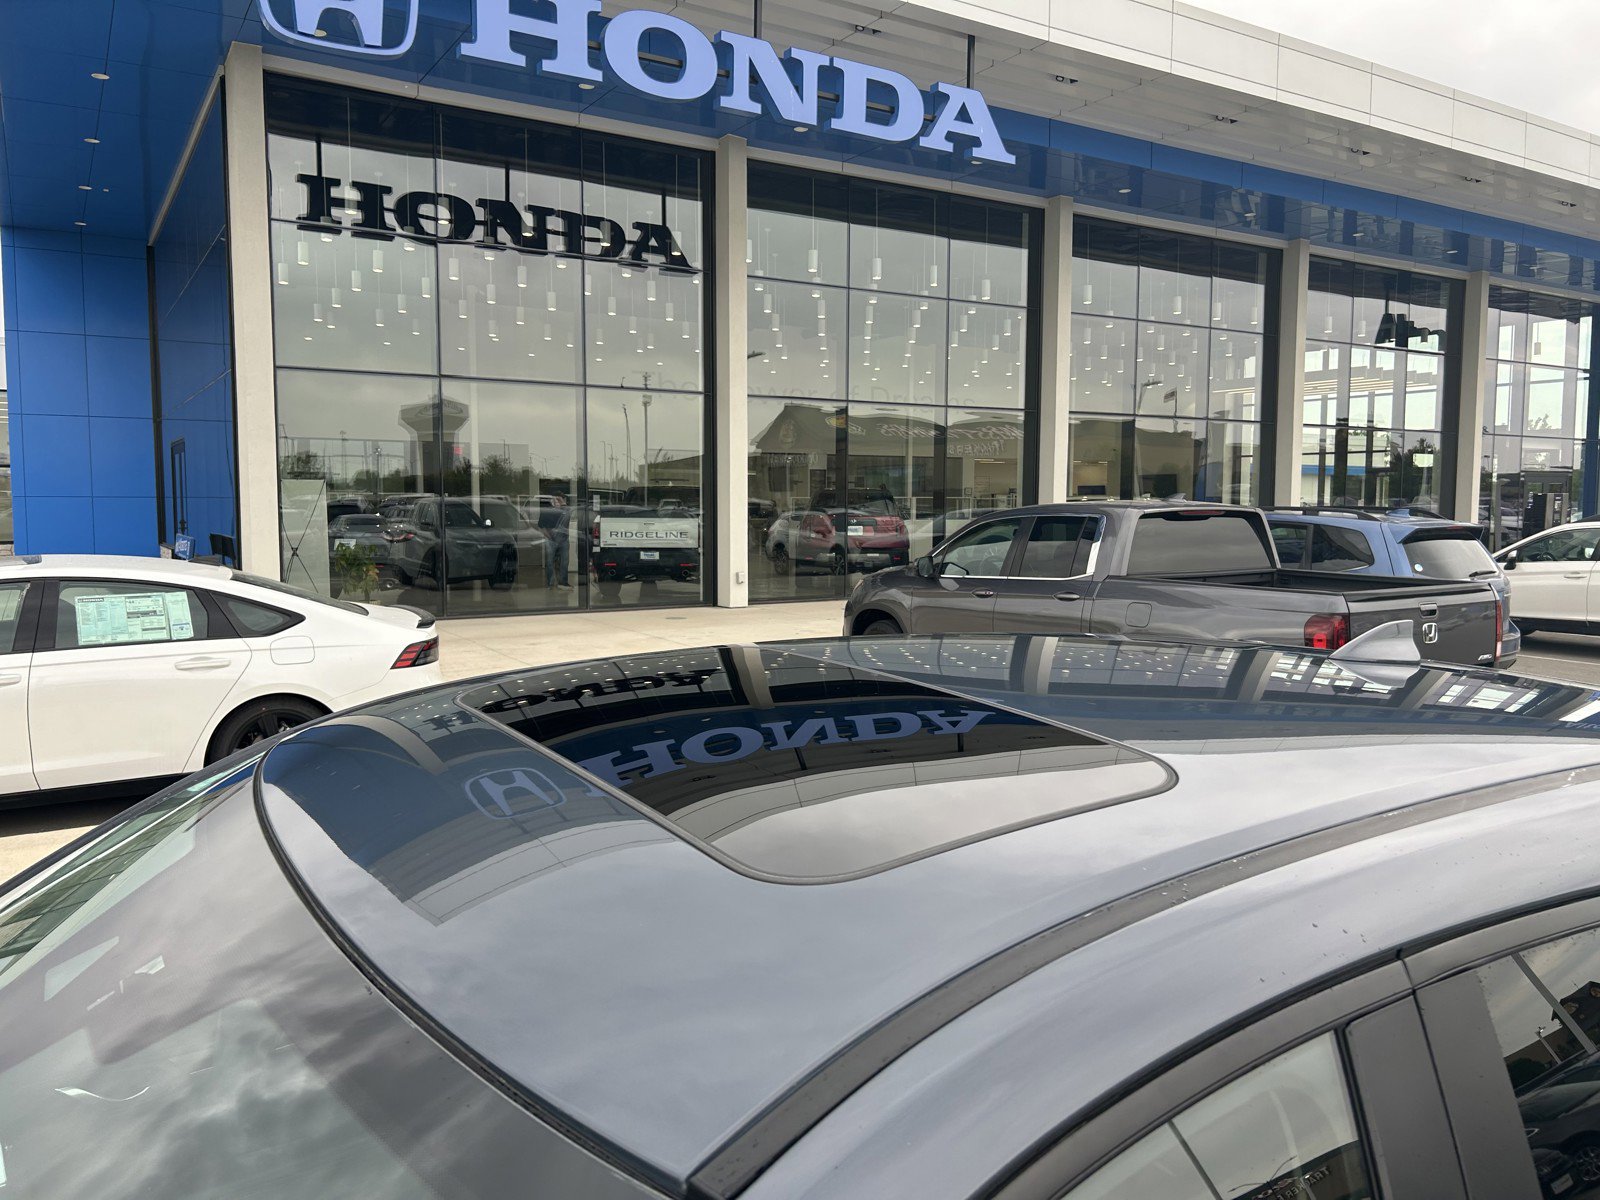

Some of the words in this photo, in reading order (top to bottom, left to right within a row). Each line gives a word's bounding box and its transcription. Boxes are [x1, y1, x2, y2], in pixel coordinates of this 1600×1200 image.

[459, 0, 1017, 165] HONDA
[296, 172, 702, 275] HONDA
[608, 530, 690, 540] RIDGELINE
